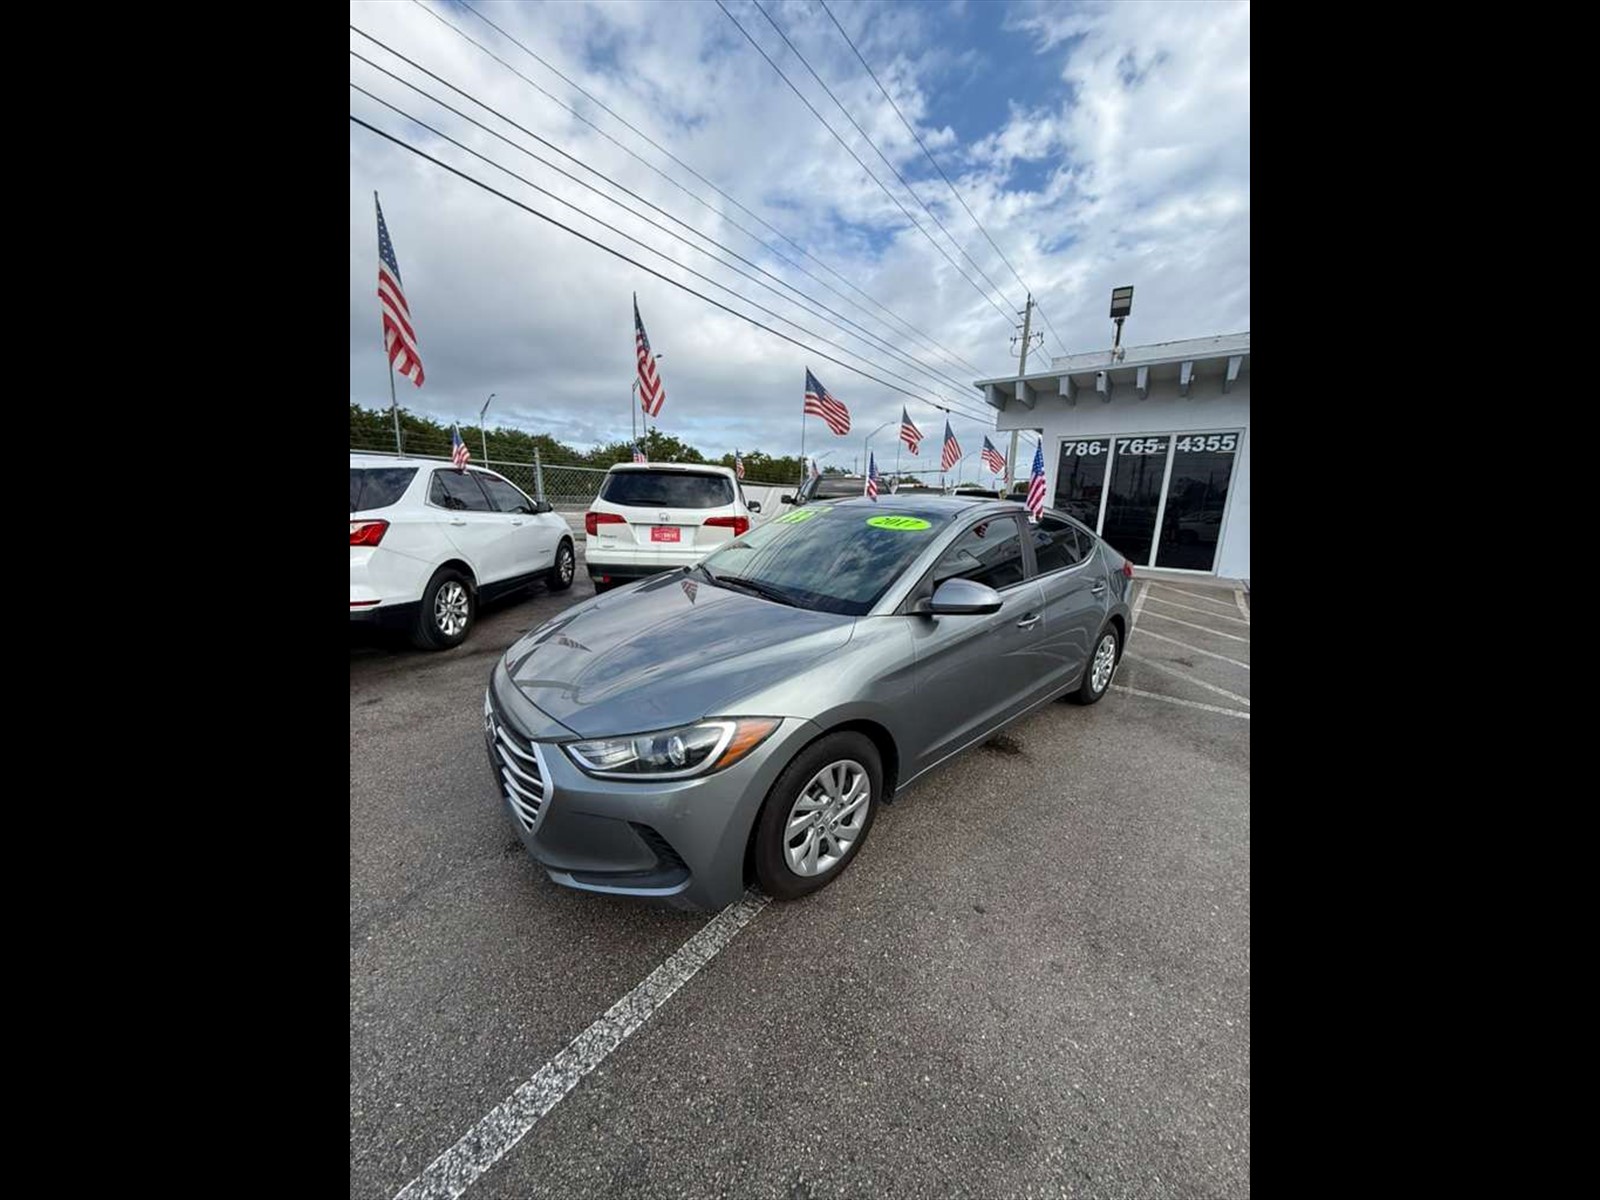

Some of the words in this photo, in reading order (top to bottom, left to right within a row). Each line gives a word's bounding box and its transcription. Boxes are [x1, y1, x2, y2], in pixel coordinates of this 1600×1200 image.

[1064, 442, 1107, 456] 786-
[1117, 438, 1165, 453] 765-
[1177, 435, 1235, 451] 4355
[874, 517, 922, 528] 2017
